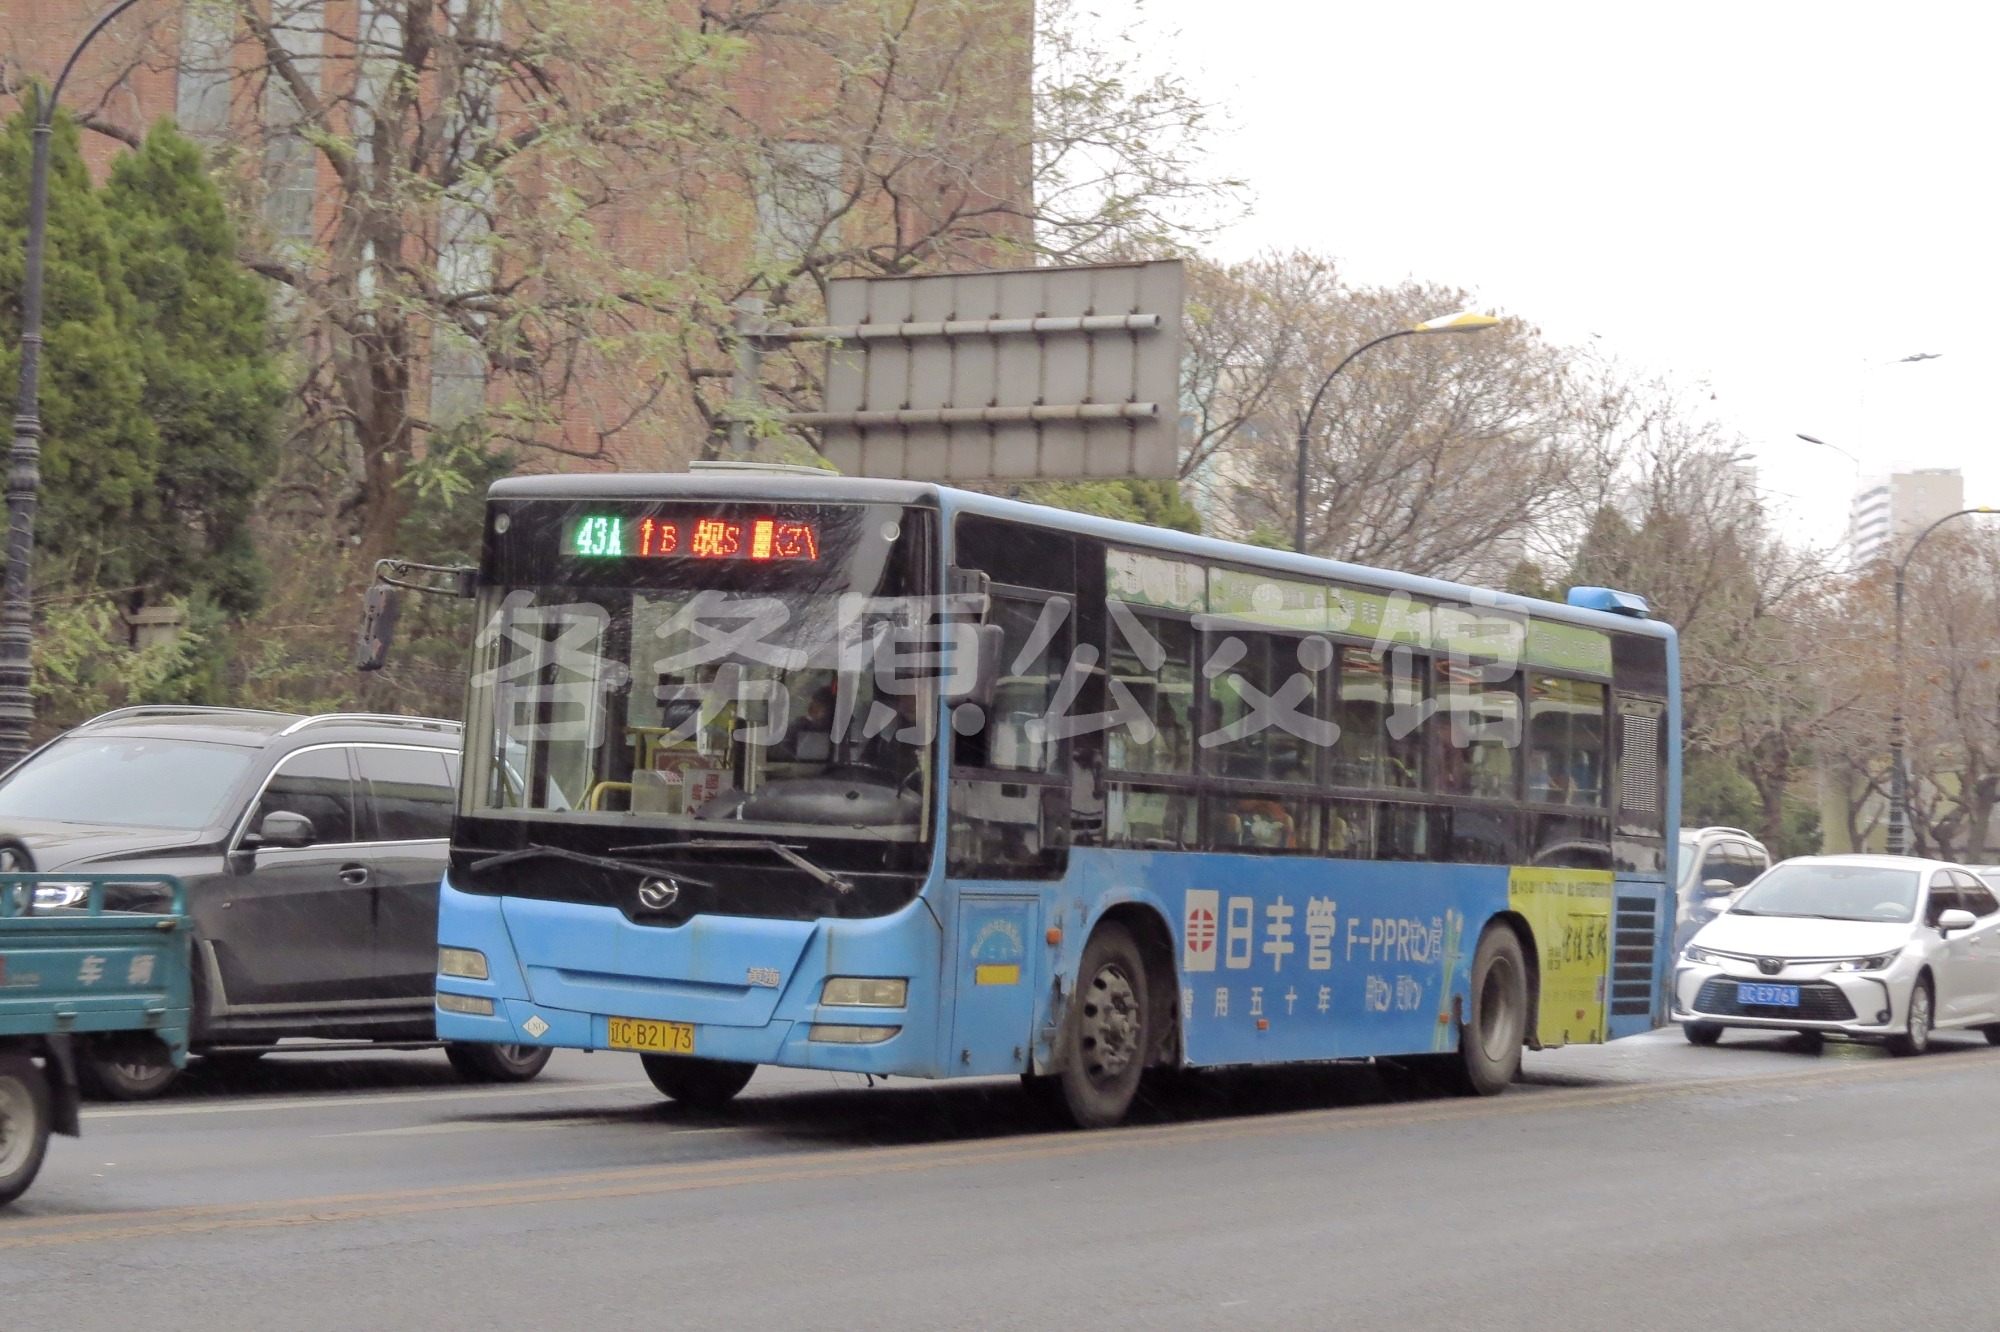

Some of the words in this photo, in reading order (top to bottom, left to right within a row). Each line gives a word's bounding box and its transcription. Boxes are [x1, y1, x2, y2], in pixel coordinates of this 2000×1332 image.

[1226, 896, 1336, 972] 日丰管
[527, 1021, 545, 1031] LNG
